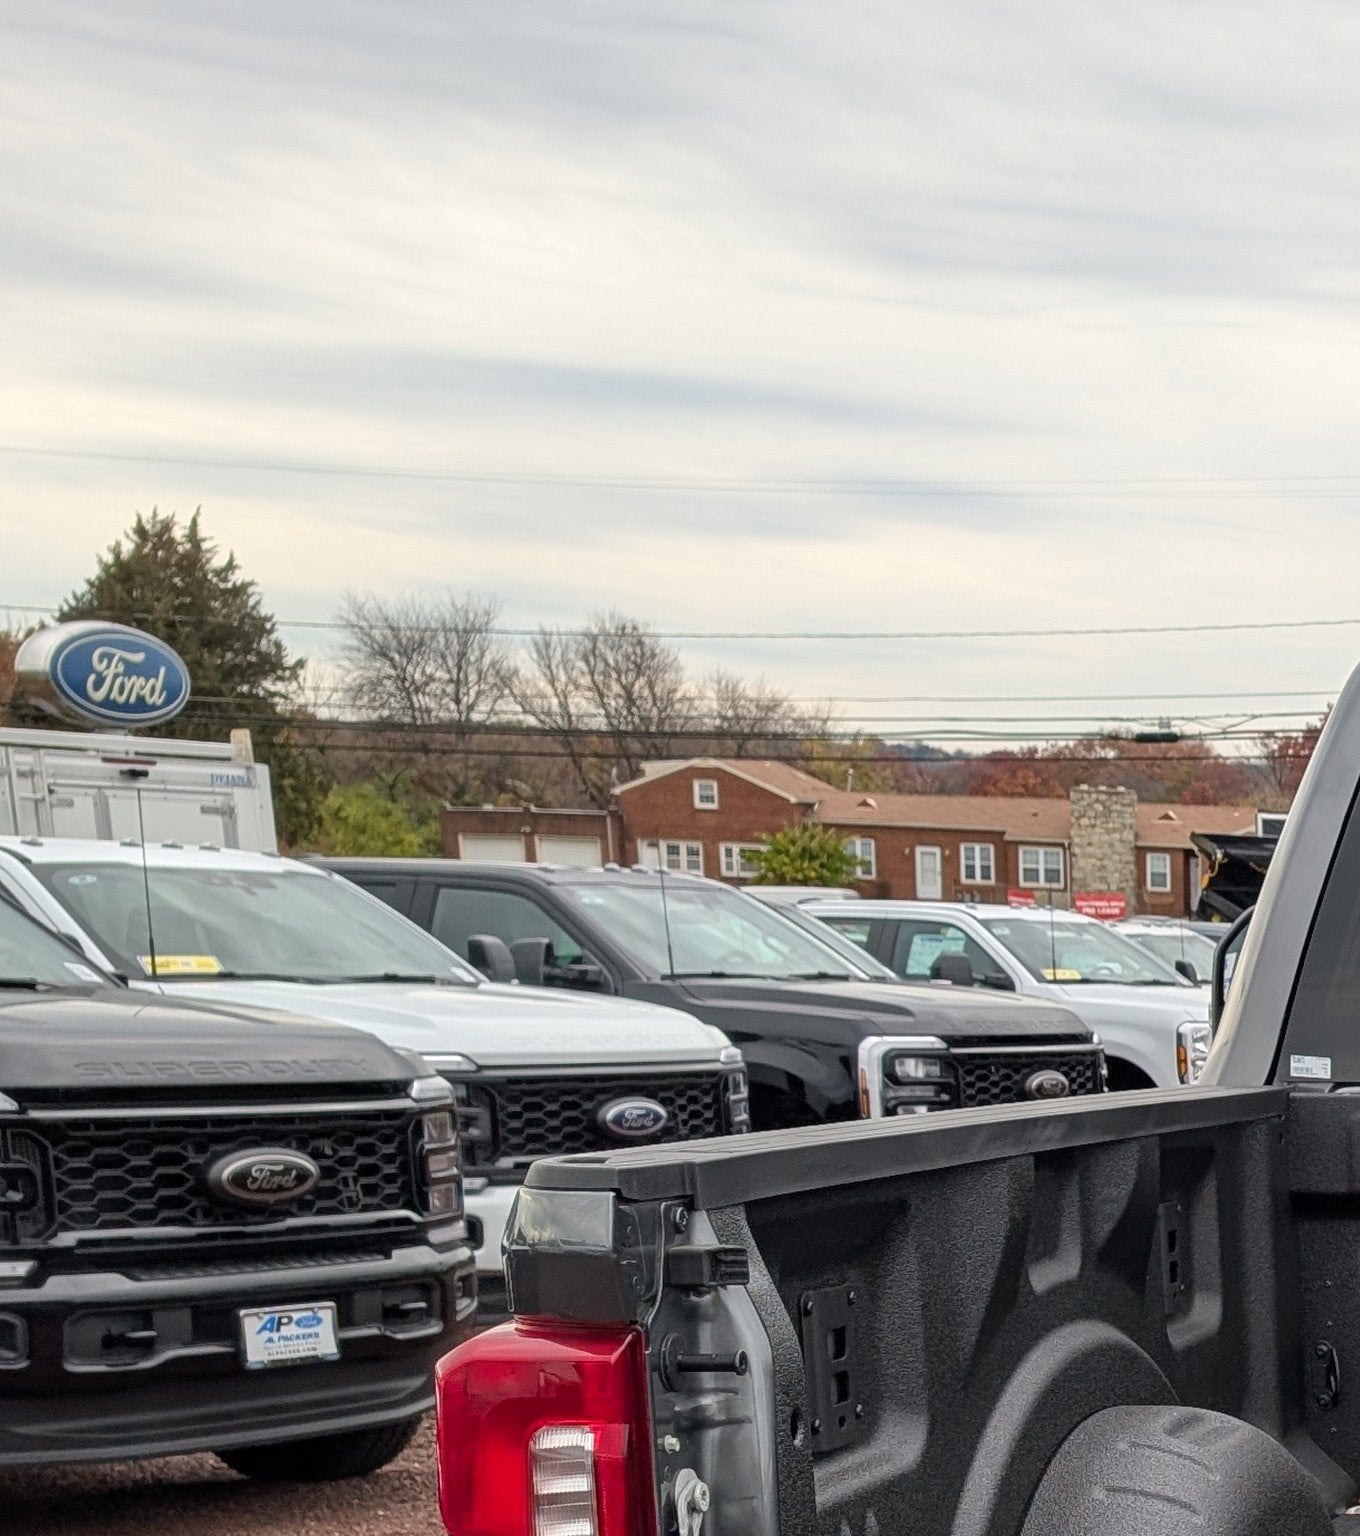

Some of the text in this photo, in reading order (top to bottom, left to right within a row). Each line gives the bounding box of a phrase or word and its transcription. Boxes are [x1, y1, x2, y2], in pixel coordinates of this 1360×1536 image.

[86, 646, 167, 706] Ford
[72, 1057, 367, 1079] SUPER DUTY
[621, 1108, 655, 1128] Ford
[246, 1162, 298, 1190] Ford
[256, 1314, 294, 1335] AP
